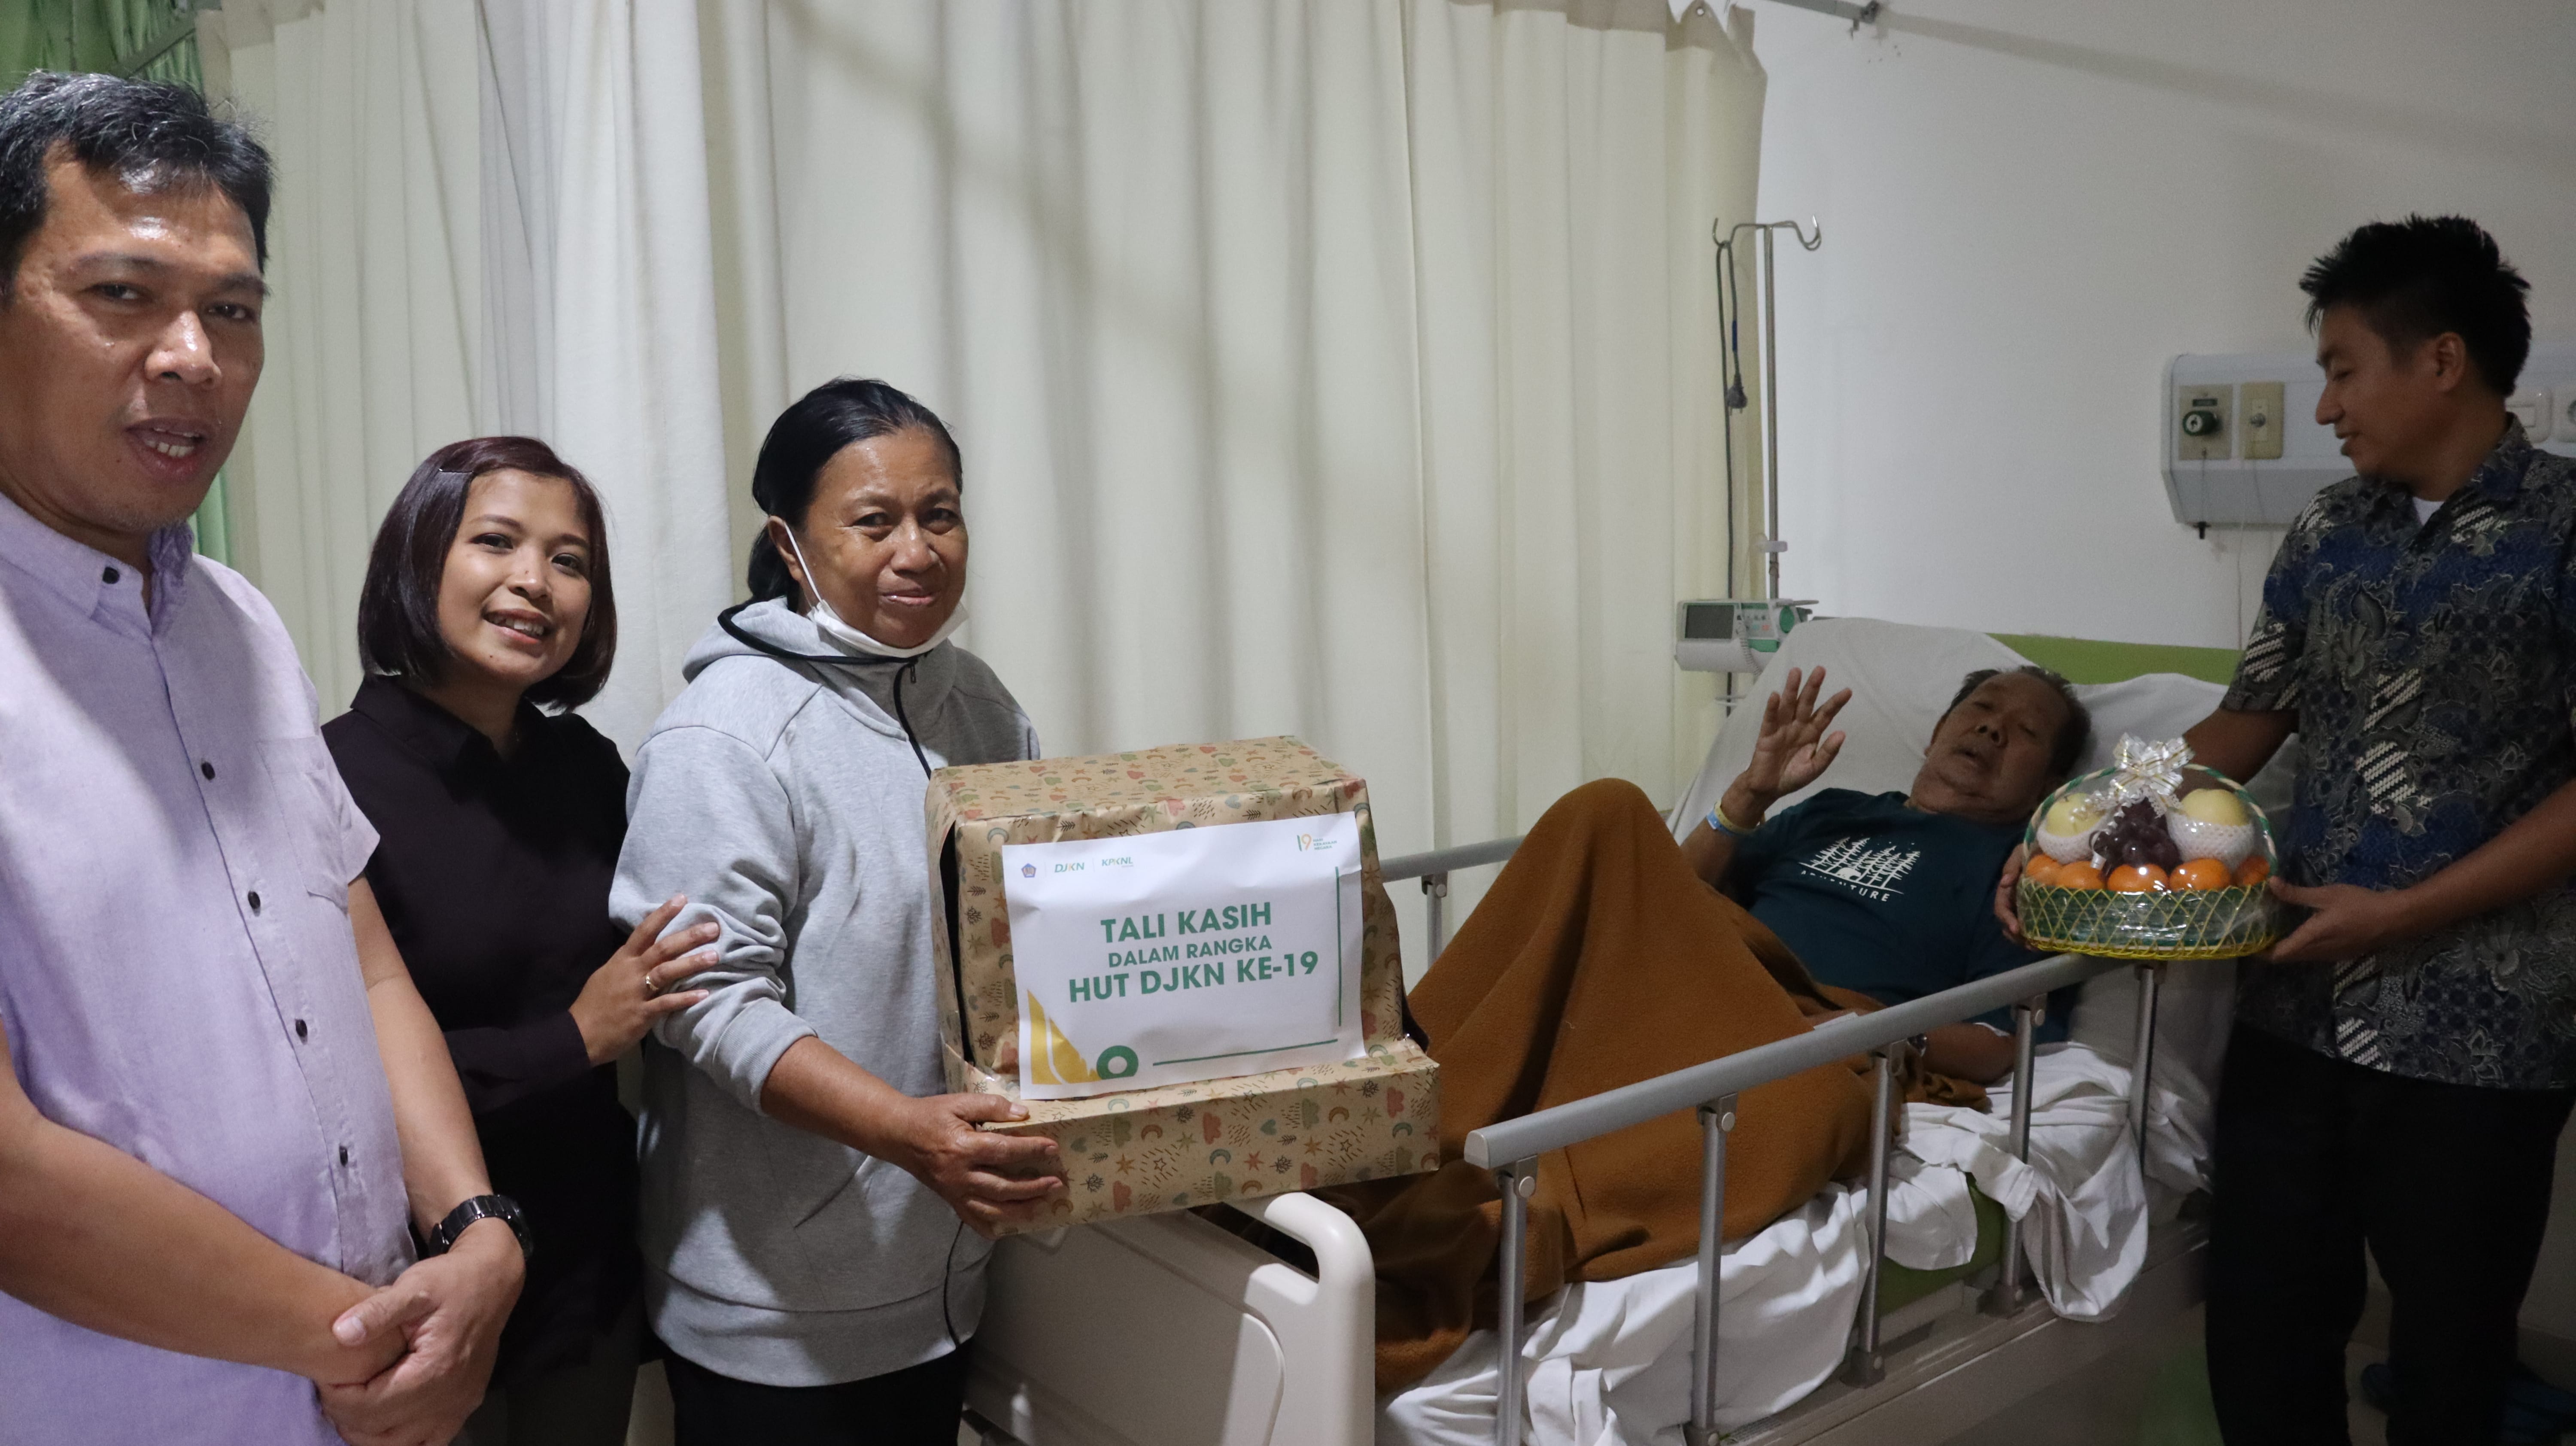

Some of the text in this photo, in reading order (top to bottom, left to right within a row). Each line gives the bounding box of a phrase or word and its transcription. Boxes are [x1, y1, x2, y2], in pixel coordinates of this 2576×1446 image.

[1054, 863, 1084, 873] DJKN
[1102, 857, 1133, 866] KPKNL
[1101, 902, 1272, 943] TALI KASIH
[1109, 936, 1272, 967] DALAM RANGKA
[1069, 951, 1318, 1002] HUT DJKN KE-19
